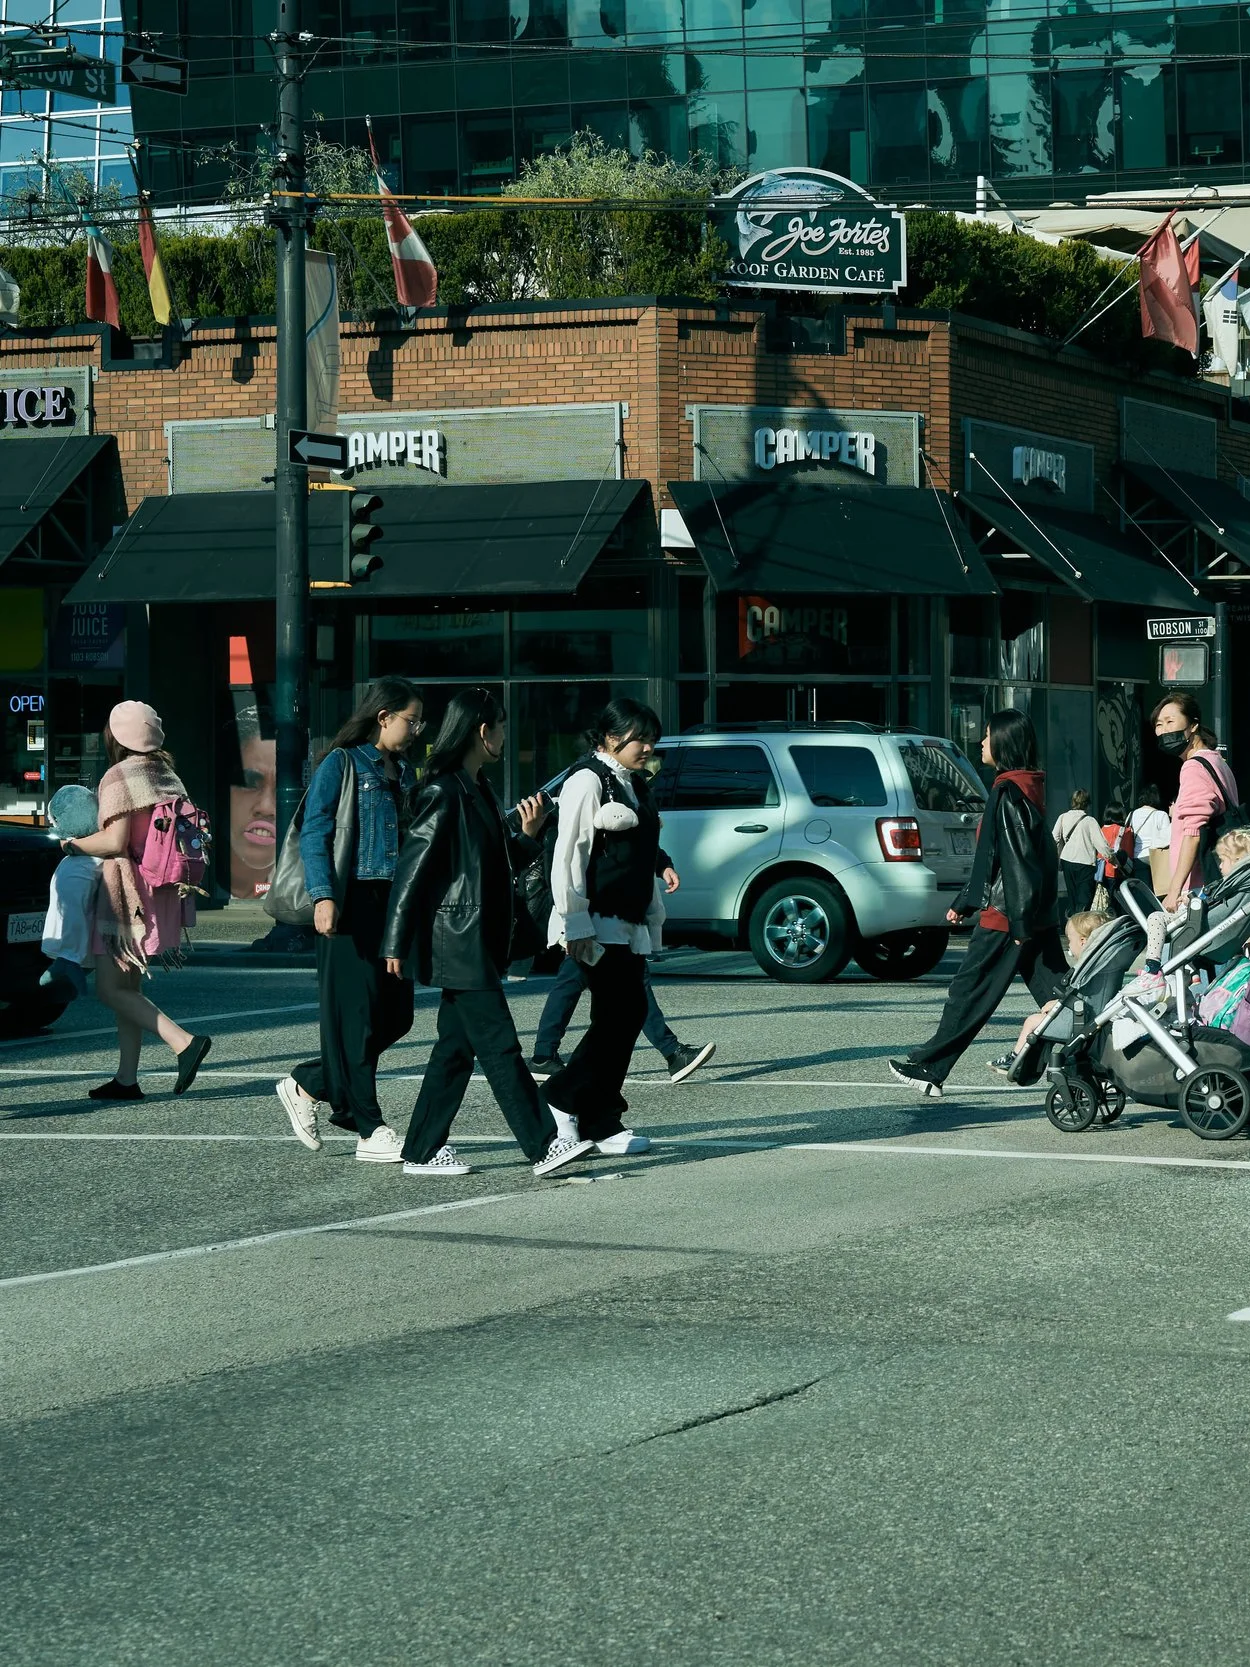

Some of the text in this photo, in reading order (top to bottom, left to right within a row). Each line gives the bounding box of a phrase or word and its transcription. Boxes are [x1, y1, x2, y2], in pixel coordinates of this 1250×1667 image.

[762, 217, 890, 261] Joe Fortes
[838, 247, 875, 257] Est. 1985
[725, 259, 885, 282] ROOF GARDEN CAFÉ
[0, 386, 67, 422] ICE
[335, 430, 441, 475] AMPER
[754, 427, 876, 476] CAMPER
[1013, 446, 1066, 494] CAMPER
[72, 617, 108, 636] JUICE
[747, 605, 848, 646] CAMPER
[1152, 621, 1192, 636] ROBSON
